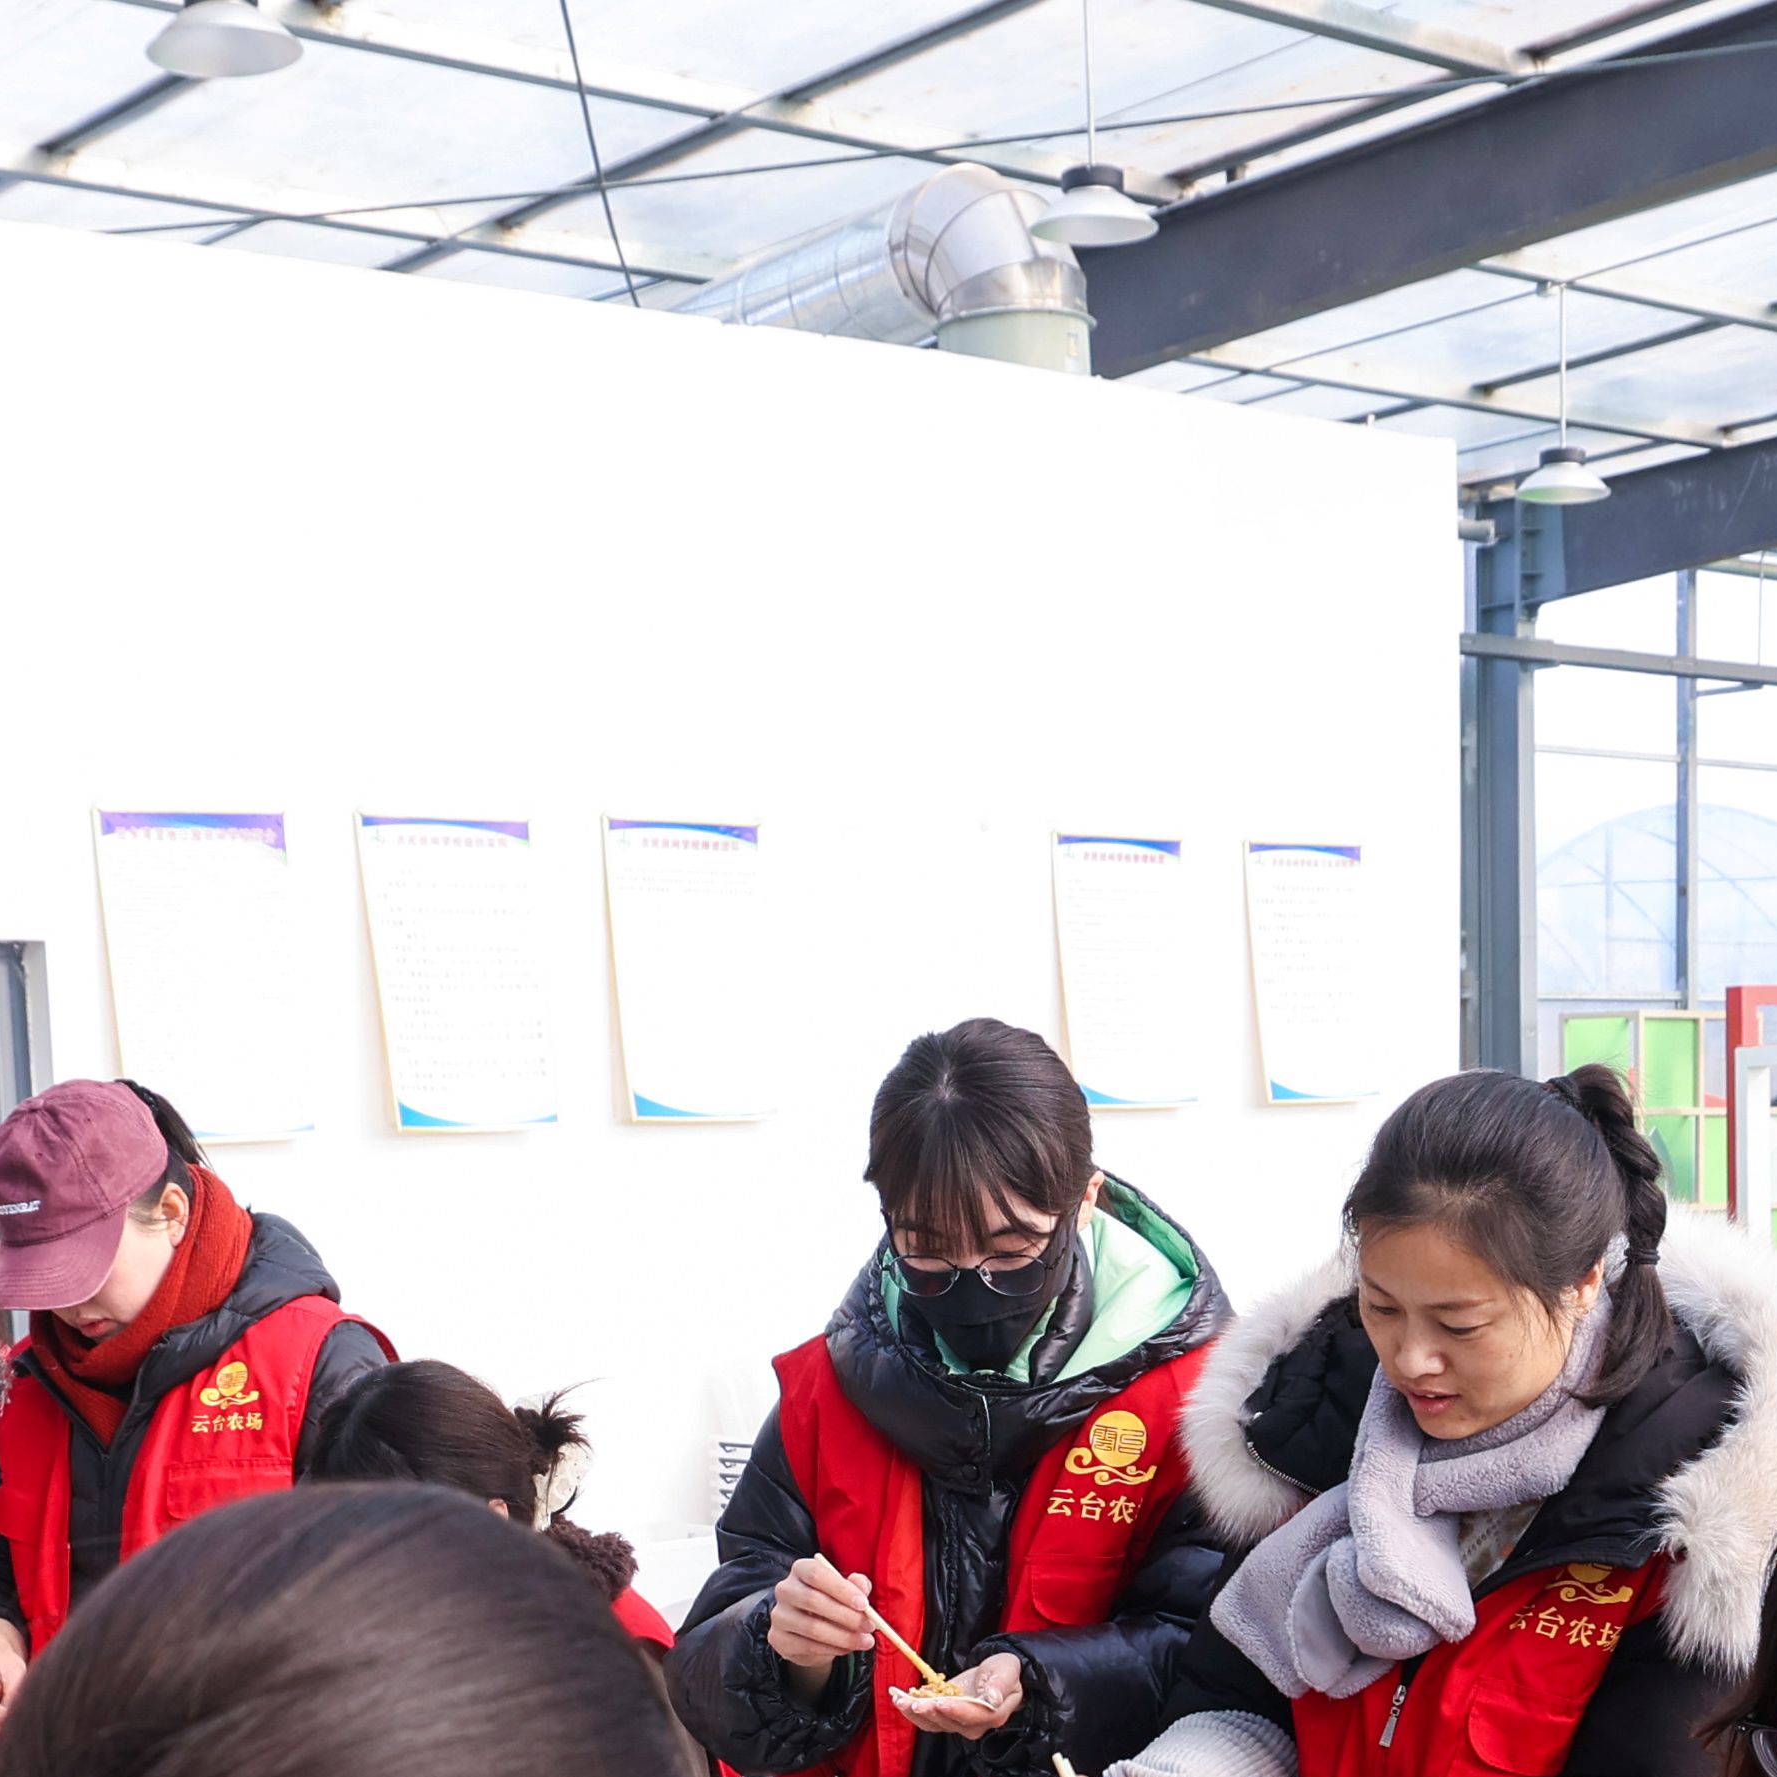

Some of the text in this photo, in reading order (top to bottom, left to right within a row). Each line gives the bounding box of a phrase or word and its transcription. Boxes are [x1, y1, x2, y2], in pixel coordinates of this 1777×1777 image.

[191, 1411, 263, 1433] 云台农场
[1047, 1488, 1143, 1524] 云台农
